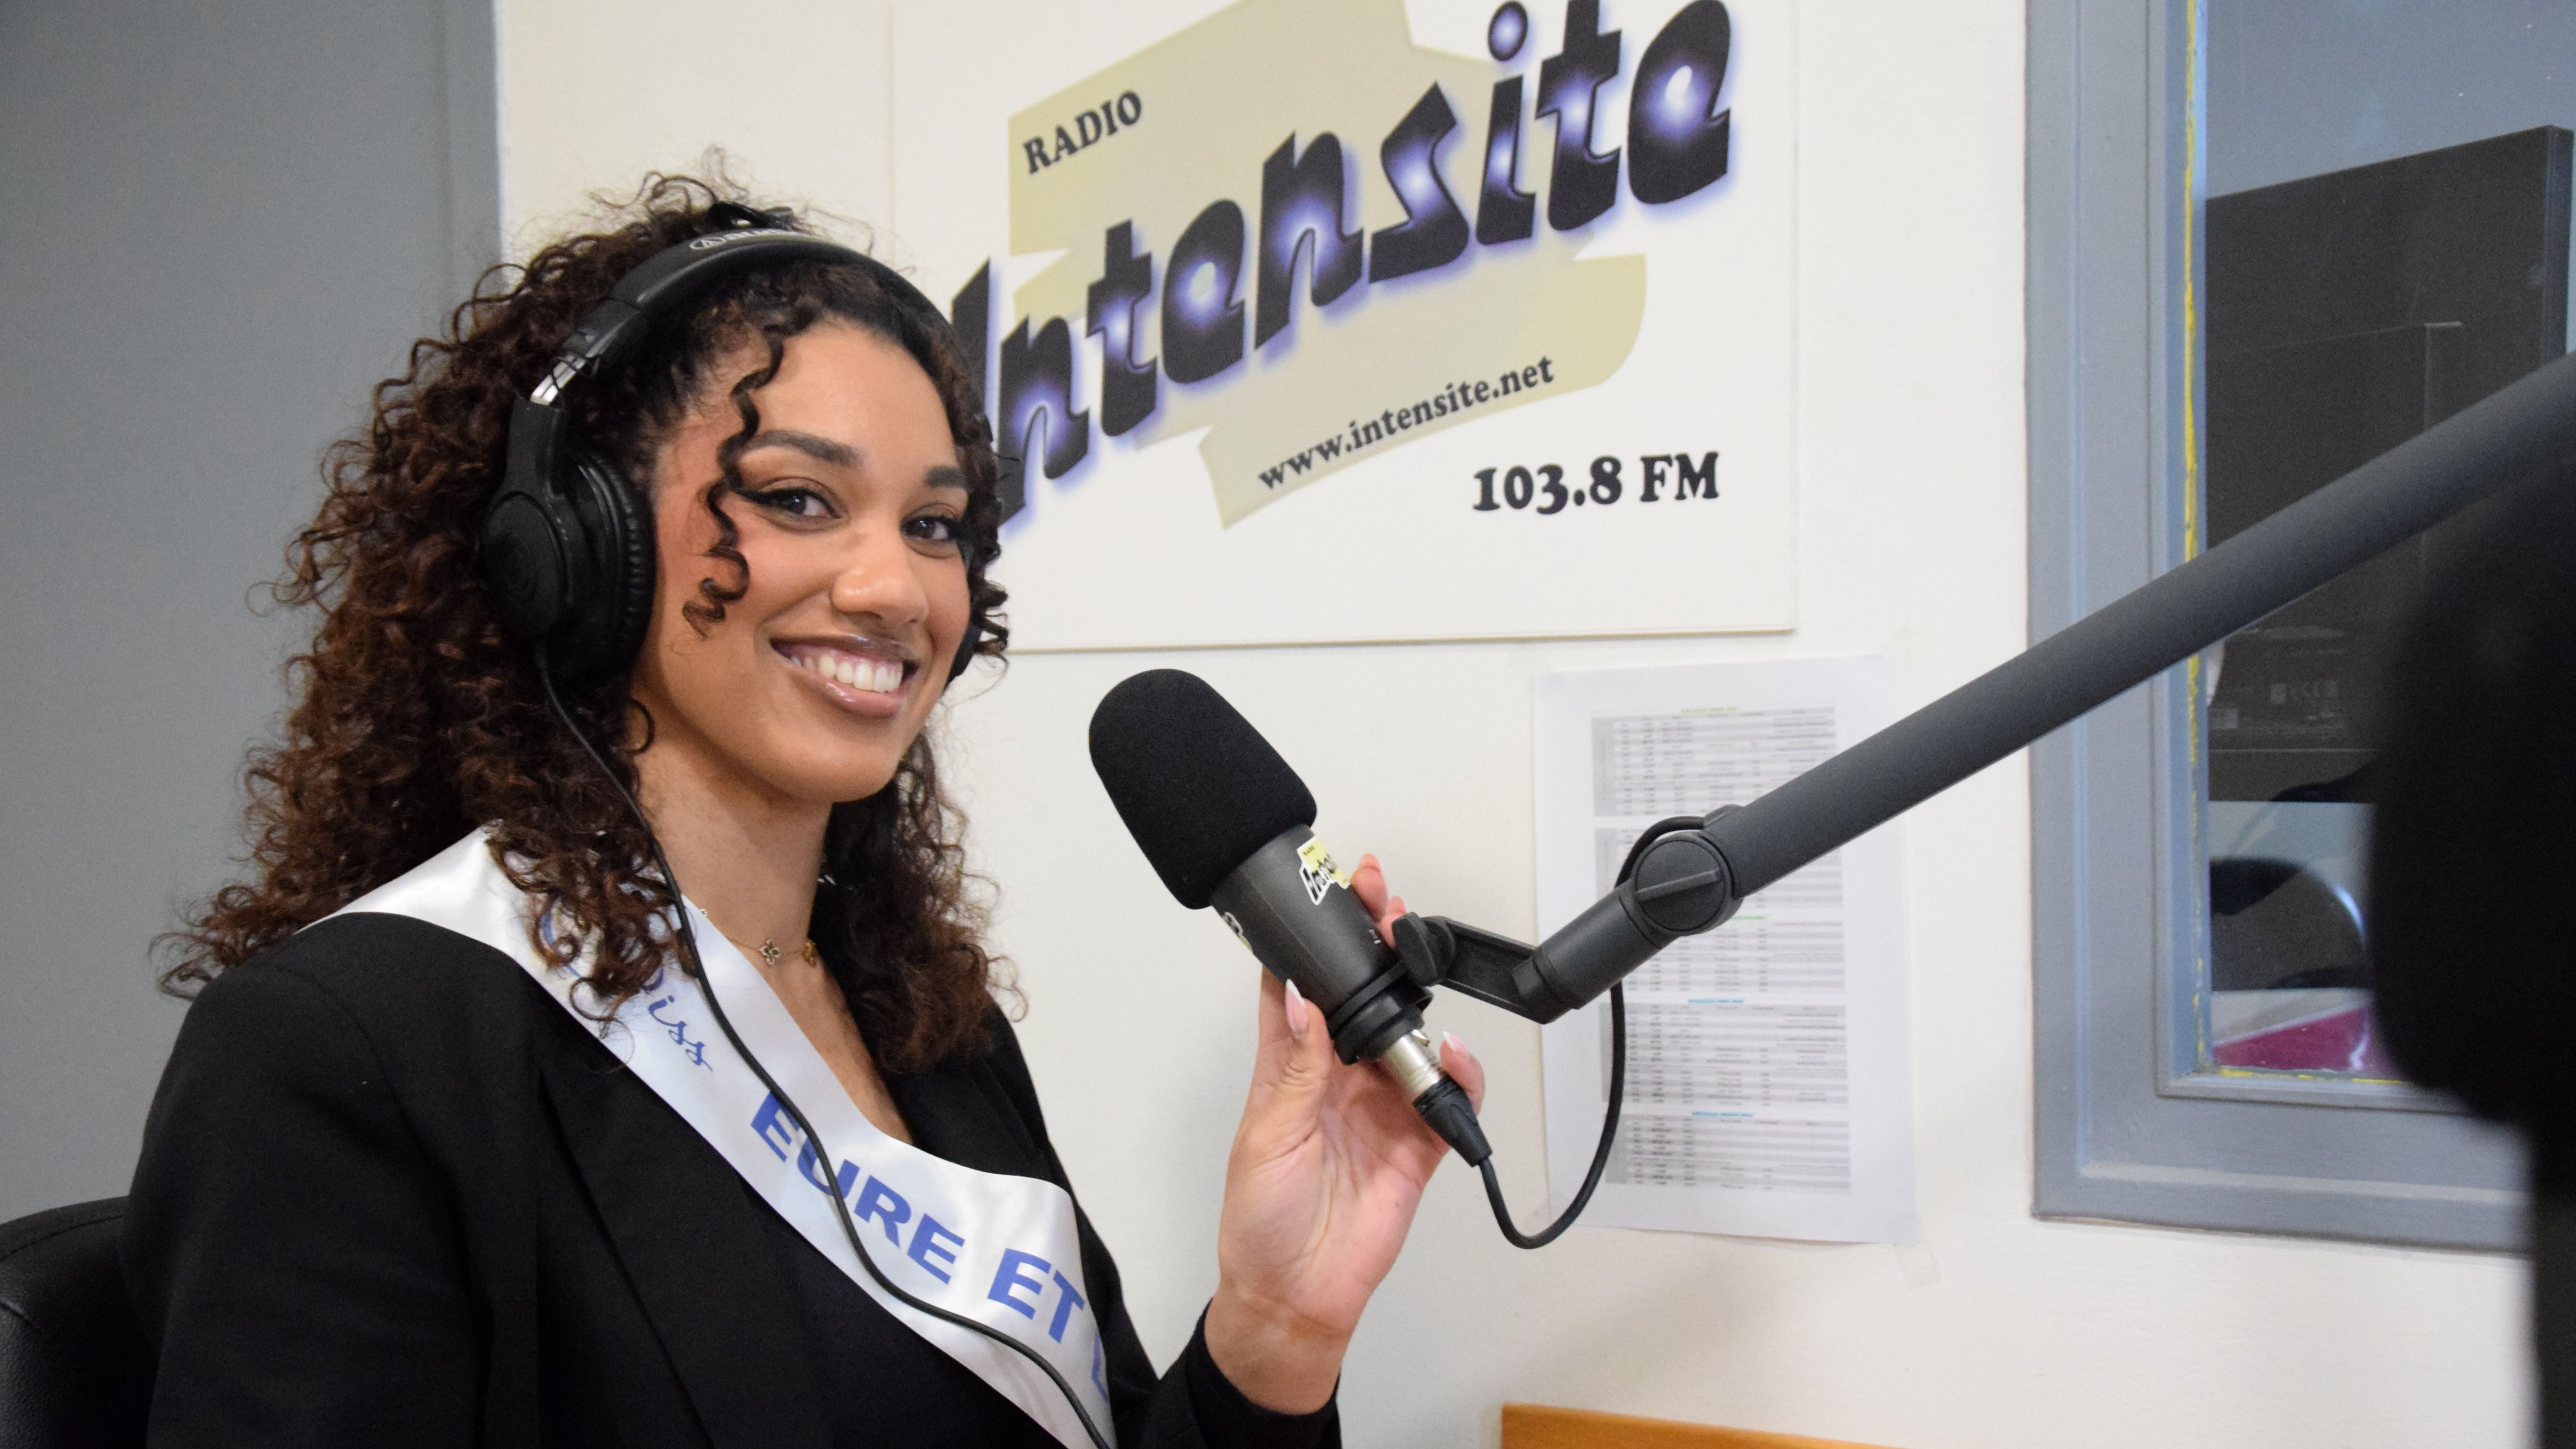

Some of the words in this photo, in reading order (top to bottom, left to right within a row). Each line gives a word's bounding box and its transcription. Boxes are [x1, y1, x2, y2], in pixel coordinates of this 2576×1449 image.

[1024, 90, 1142, 174] RADIO
[1259, 355, 1554, 490] www.intensite.net
[1473, 455, 1622, 515] 103.8
[1639, 451, 1719, 502] FM
[750, 1089, 966, 1285] EURE
[987, 1248, 1085, 1344] ET
